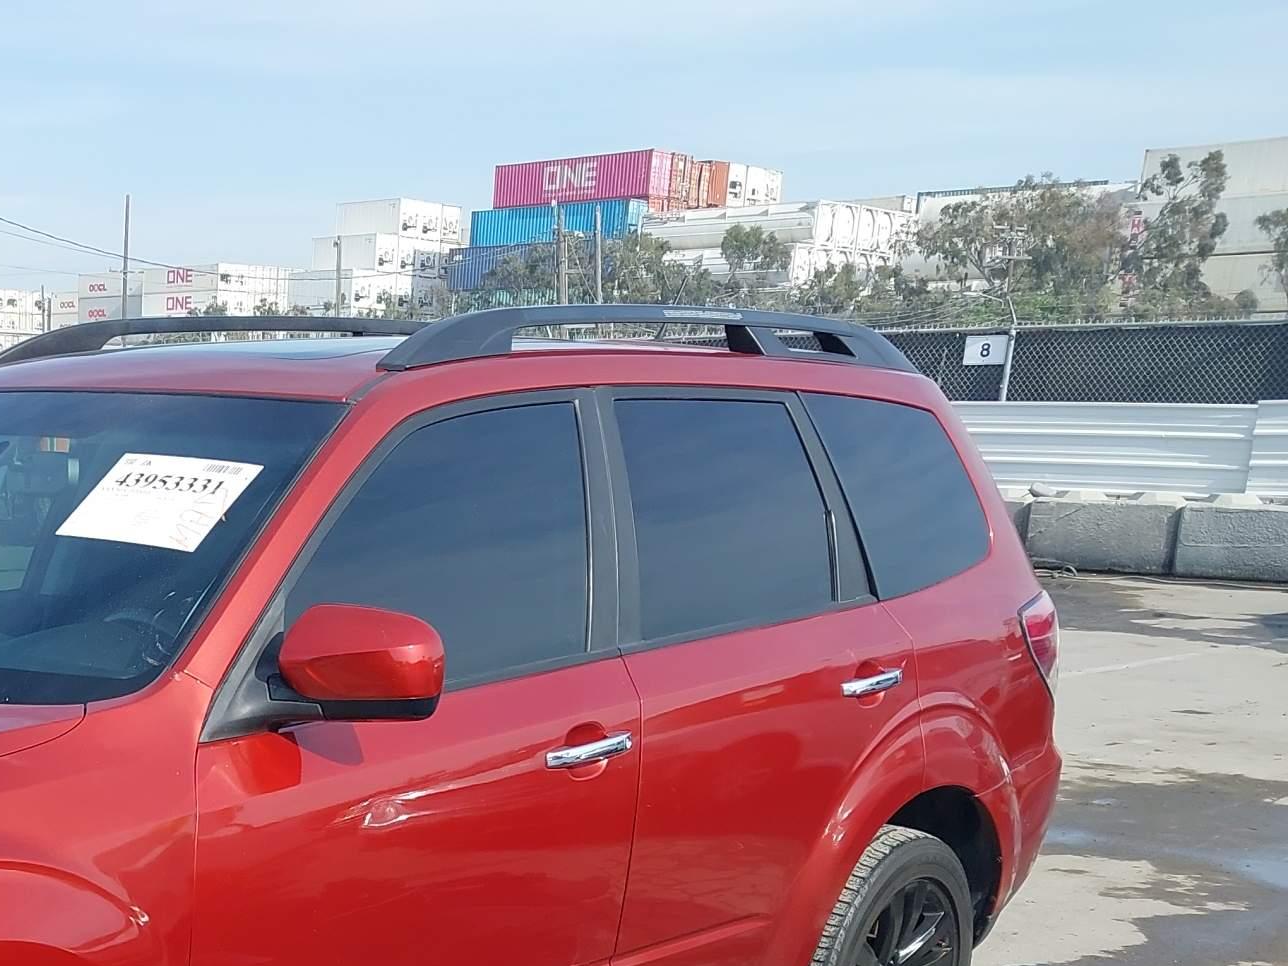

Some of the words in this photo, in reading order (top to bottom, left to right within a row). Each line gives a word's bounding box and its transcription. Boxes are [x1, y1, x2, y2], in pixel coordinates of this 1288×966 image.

[543, 161, 597, 191] ONE
[167, 269, 193, 285] ONE
[88, 283, 107, 293] OOCL
[166, 295, 192, 311] ONE
[88, 309, 107, 318] OOCL
[980, 342, 991, 358] 8
[115, 472, 225, 495] 43953331
